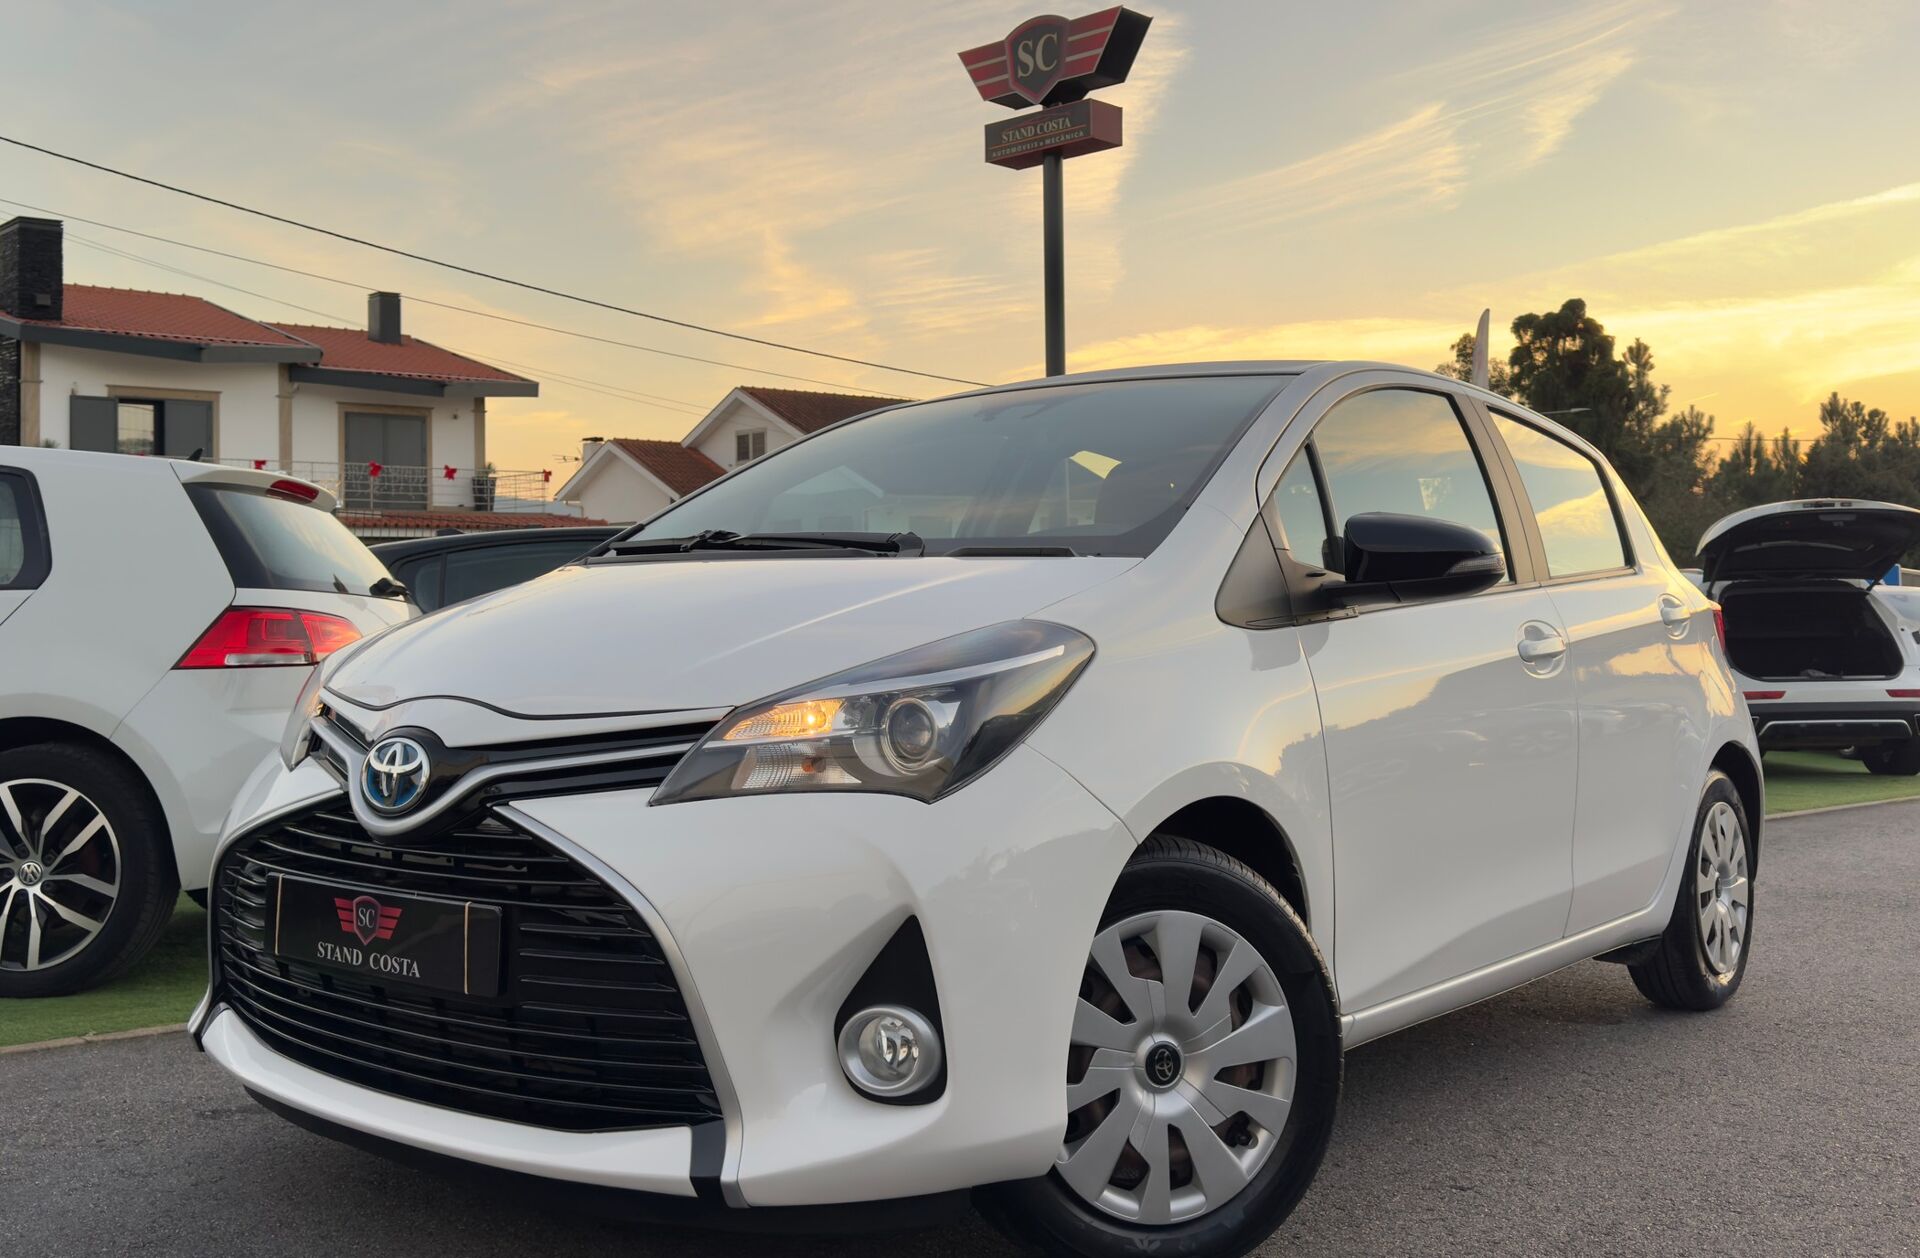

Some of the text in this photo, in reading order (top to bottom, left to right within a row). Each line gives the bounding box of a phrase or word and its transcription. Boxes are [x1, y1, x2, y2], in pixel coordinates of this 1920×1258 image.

[1018, 33, 1058, 77] SC
[1002, 117, 1072, 143] STAND COSTA
[357, 907, 375, 929] SC
[317, 941, 421, 978] STAND COSTA
